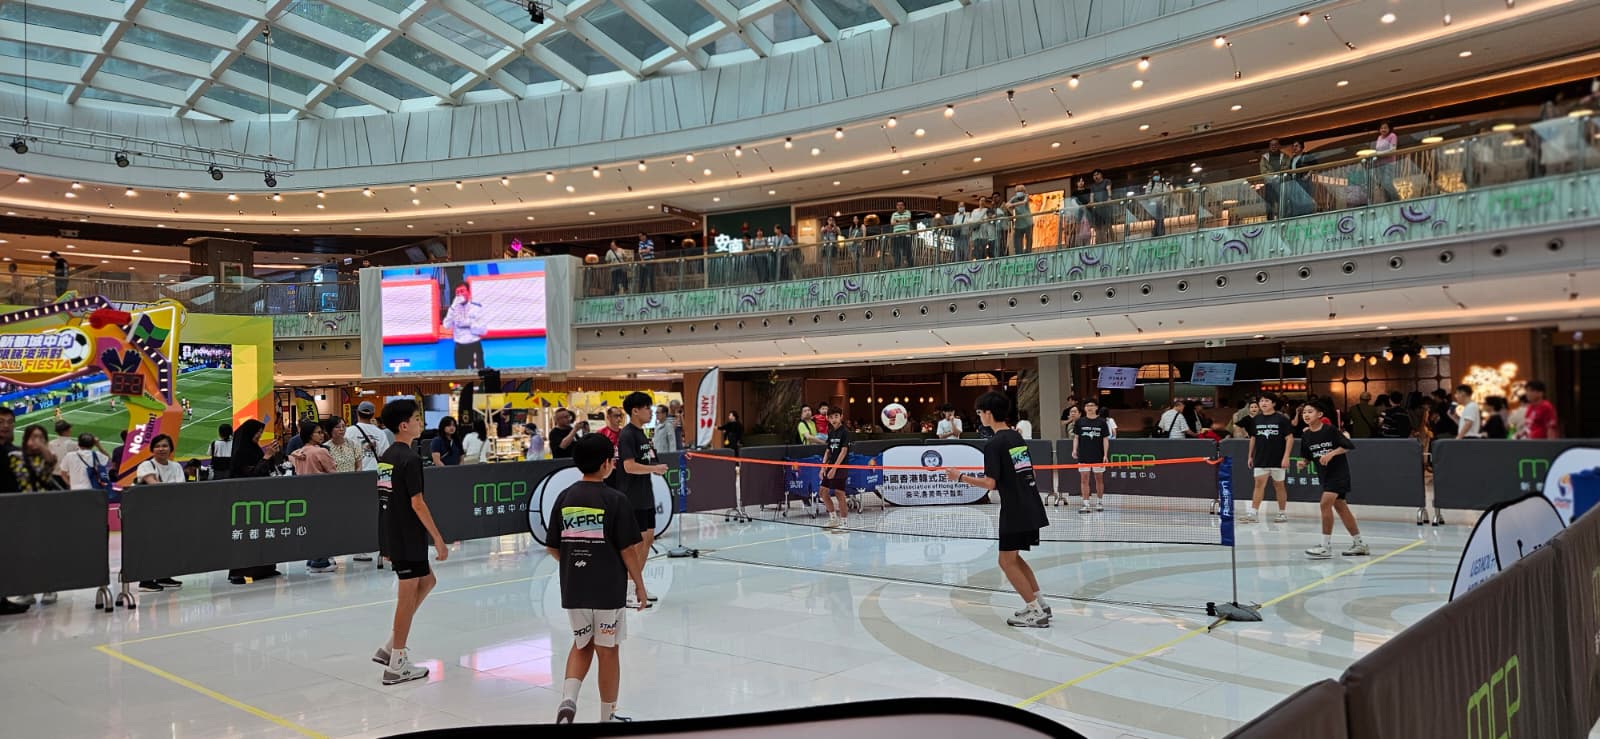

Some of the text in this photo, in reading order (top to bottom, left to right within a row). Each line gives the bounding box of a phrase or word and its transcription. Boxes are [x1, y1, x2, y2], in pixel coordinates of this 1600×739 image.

[25, 359, 71, 370] FIESTA
[40, 399, 54, 409] VISA
[701, 395, 710, 416] UNY
[128, 424, 146, 454] No.1
[1110, 454, 1156, 470] MCP
[473, 481, 527, 504] MCP
[231, 499, 307, 526] MCP
[231, 526, 307, 542] 新都城中心
